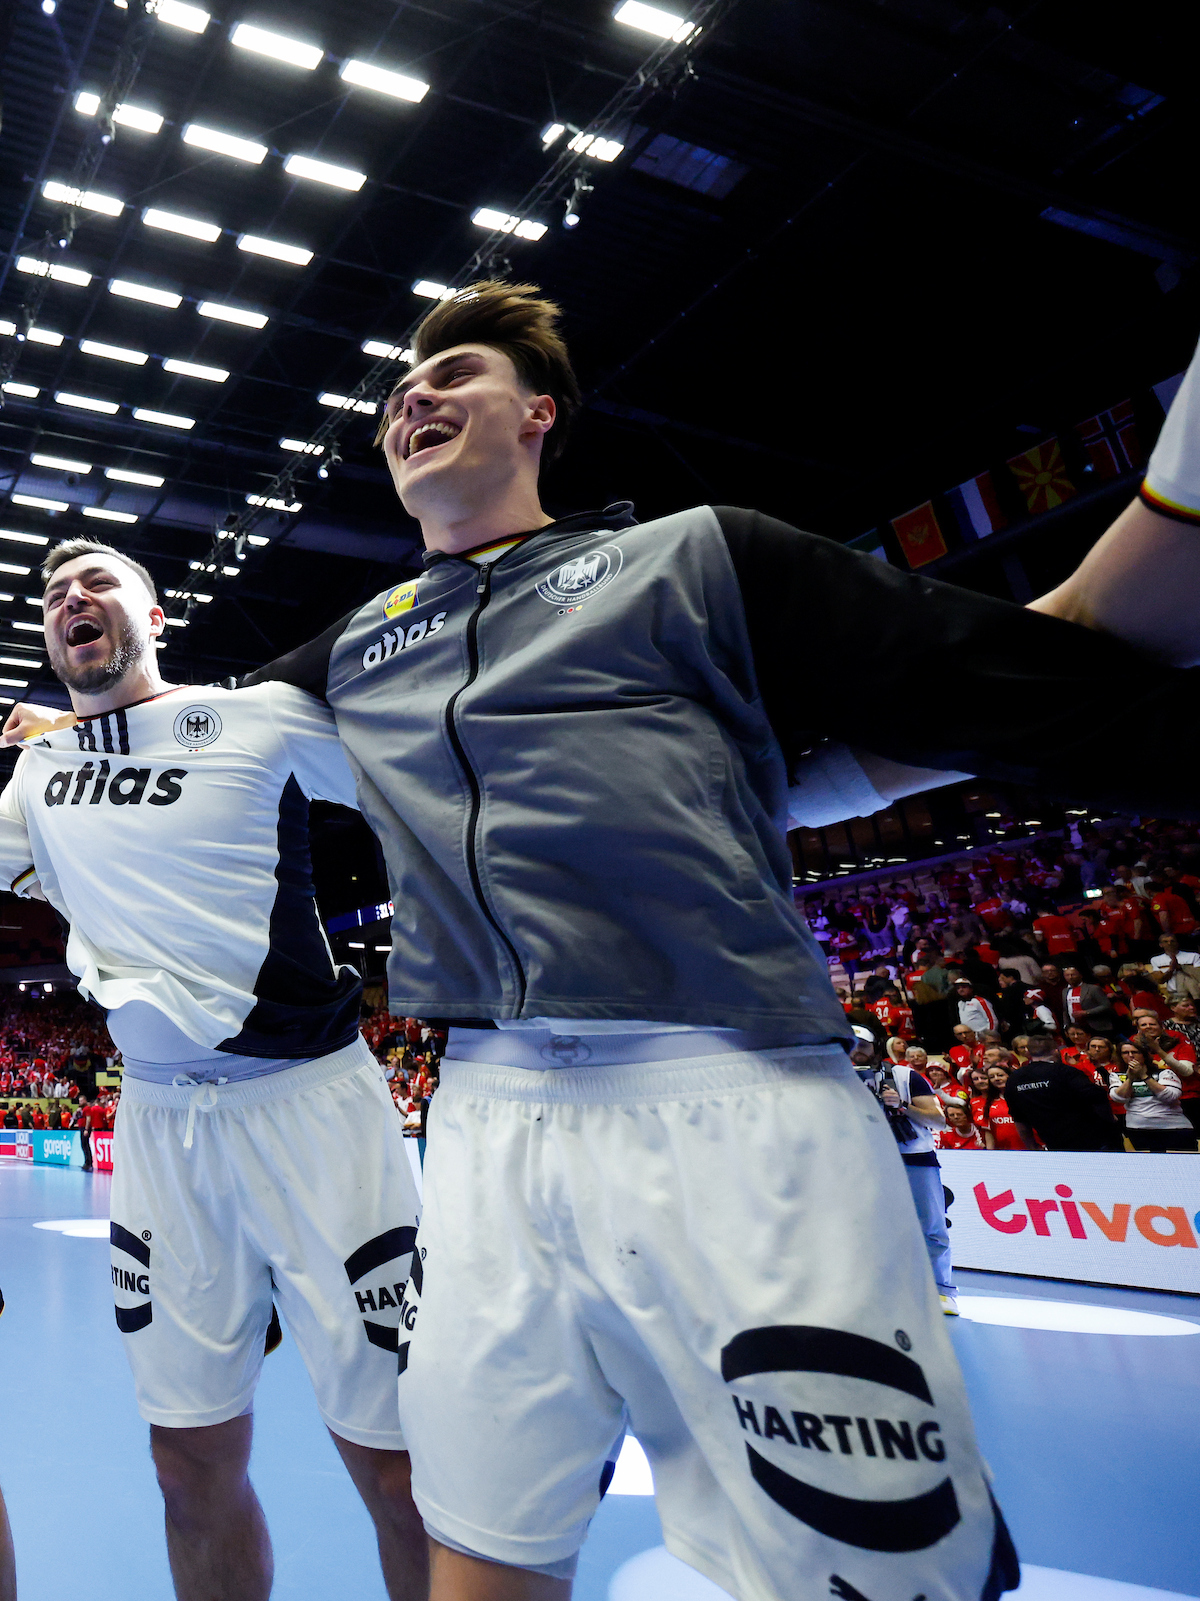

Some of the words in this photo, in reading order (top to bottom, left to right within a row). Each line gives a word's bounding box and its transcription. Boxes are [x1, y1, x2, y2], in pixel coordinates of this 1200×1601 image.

[362, 611, 448, 671] atlas
[44, 759, 189, 807] atlas
[1016, 1080, 1050, 1092] SECURITY
[43, 1135, 72, 1160] gorenje
[973, 1181, 1200, 1249] triva
[730, 1394, 947, 1463] HARTING
